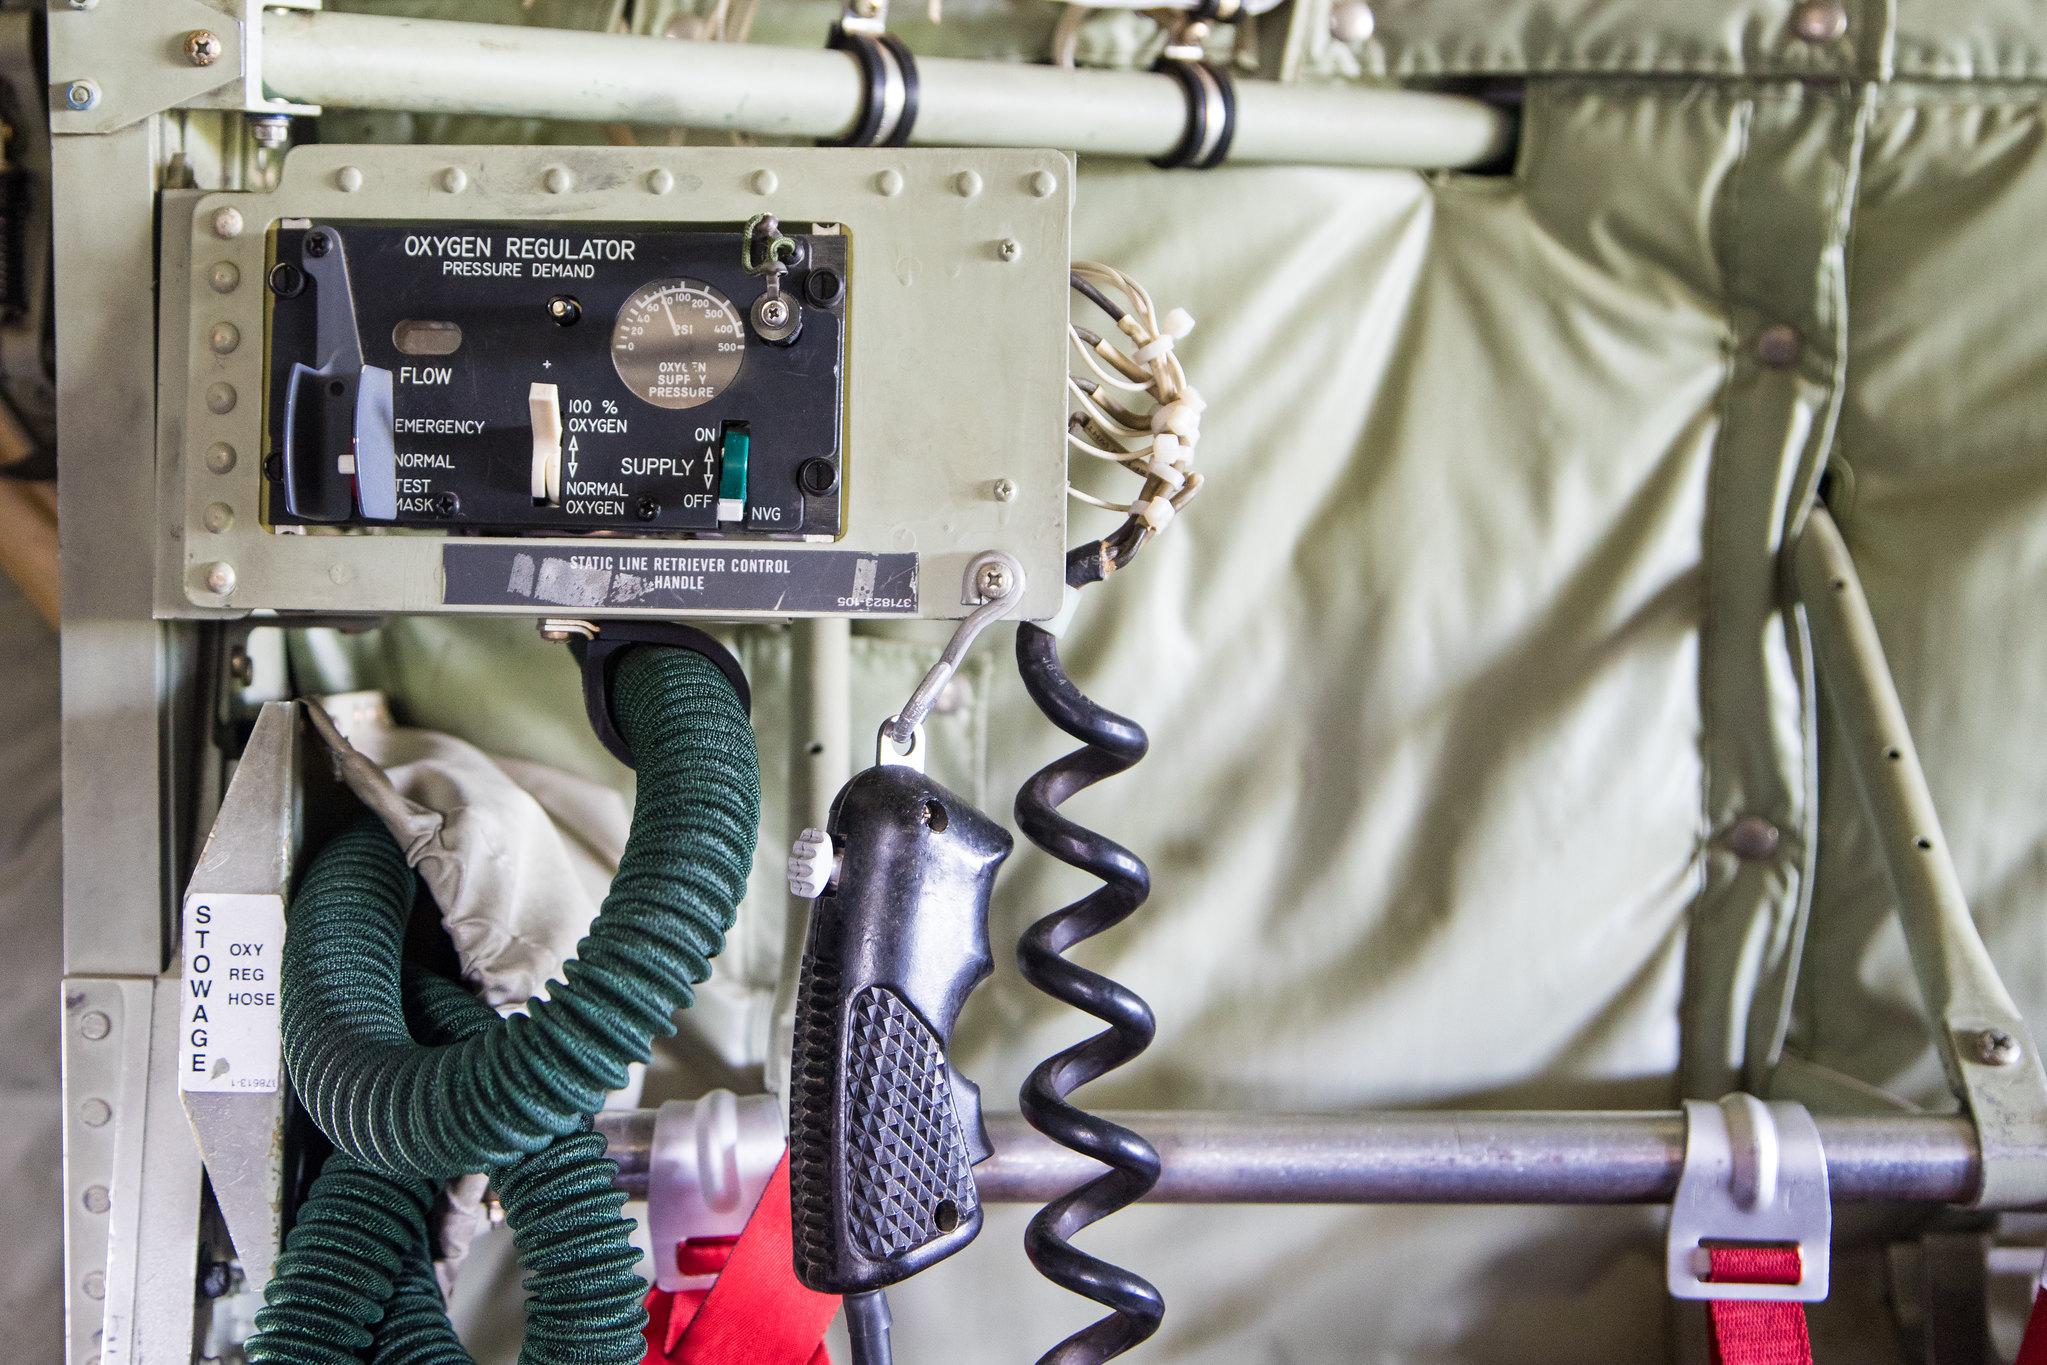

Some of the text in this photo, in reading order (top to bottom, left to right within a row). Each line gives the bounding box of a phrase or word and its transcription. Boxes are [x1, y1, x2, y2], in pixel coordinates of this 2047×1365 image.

[404, 236, 636, 261] OXYGEN REGULATOR
[442, 261, 595, 279] PRESSURE DEMAND
[675, 292, 691, 302] 100
[691, 298, 710, 309] 200
[646, 303, 659, 312] 60
[704, 309, 724, 319] 300
[637, 314, 650, 323] 40
[630, 325, 644, 336] 20
[714, 324, 733, 334] 400
[627, 342, 635, 351] 0
[717, 342, 737, 352] 500
[400, 367, 452, 385] FLOW
[658, 374, 707, 385] SUPPY
[649, 386, 714, 398] PRESSURE
[568, 399, 618, 415] 100 %
[395, 419, 486, 434] EMERGENCY
[568, 418, 628, 433] OXYGEN
[694, 427, 716, 442] ON
[396, 453, 455, 469] NORMAL
[620, 458, 695, 477] SUPPLY
[396, 478, 431, 493] TEST
[566, 481, 629, 497] NORMAL
[566, 500, 625, 515] OXYGEN
[683, 493, 714, 508] OFF
[751, 506, 781, 521] NVG
[570, 555, 791, 574] STATIC LINE RETRIEVER CONTROL
[654, 575, 705, 590] HANDLE
[837, 596, 912, 608] 371823-105
[229, 943, 264, 956] OXY
[229, 968, 264, 981] REG
[190, 905, 212, 1072] STOWAGE
[228, 993, 275, 1006] HOSE
